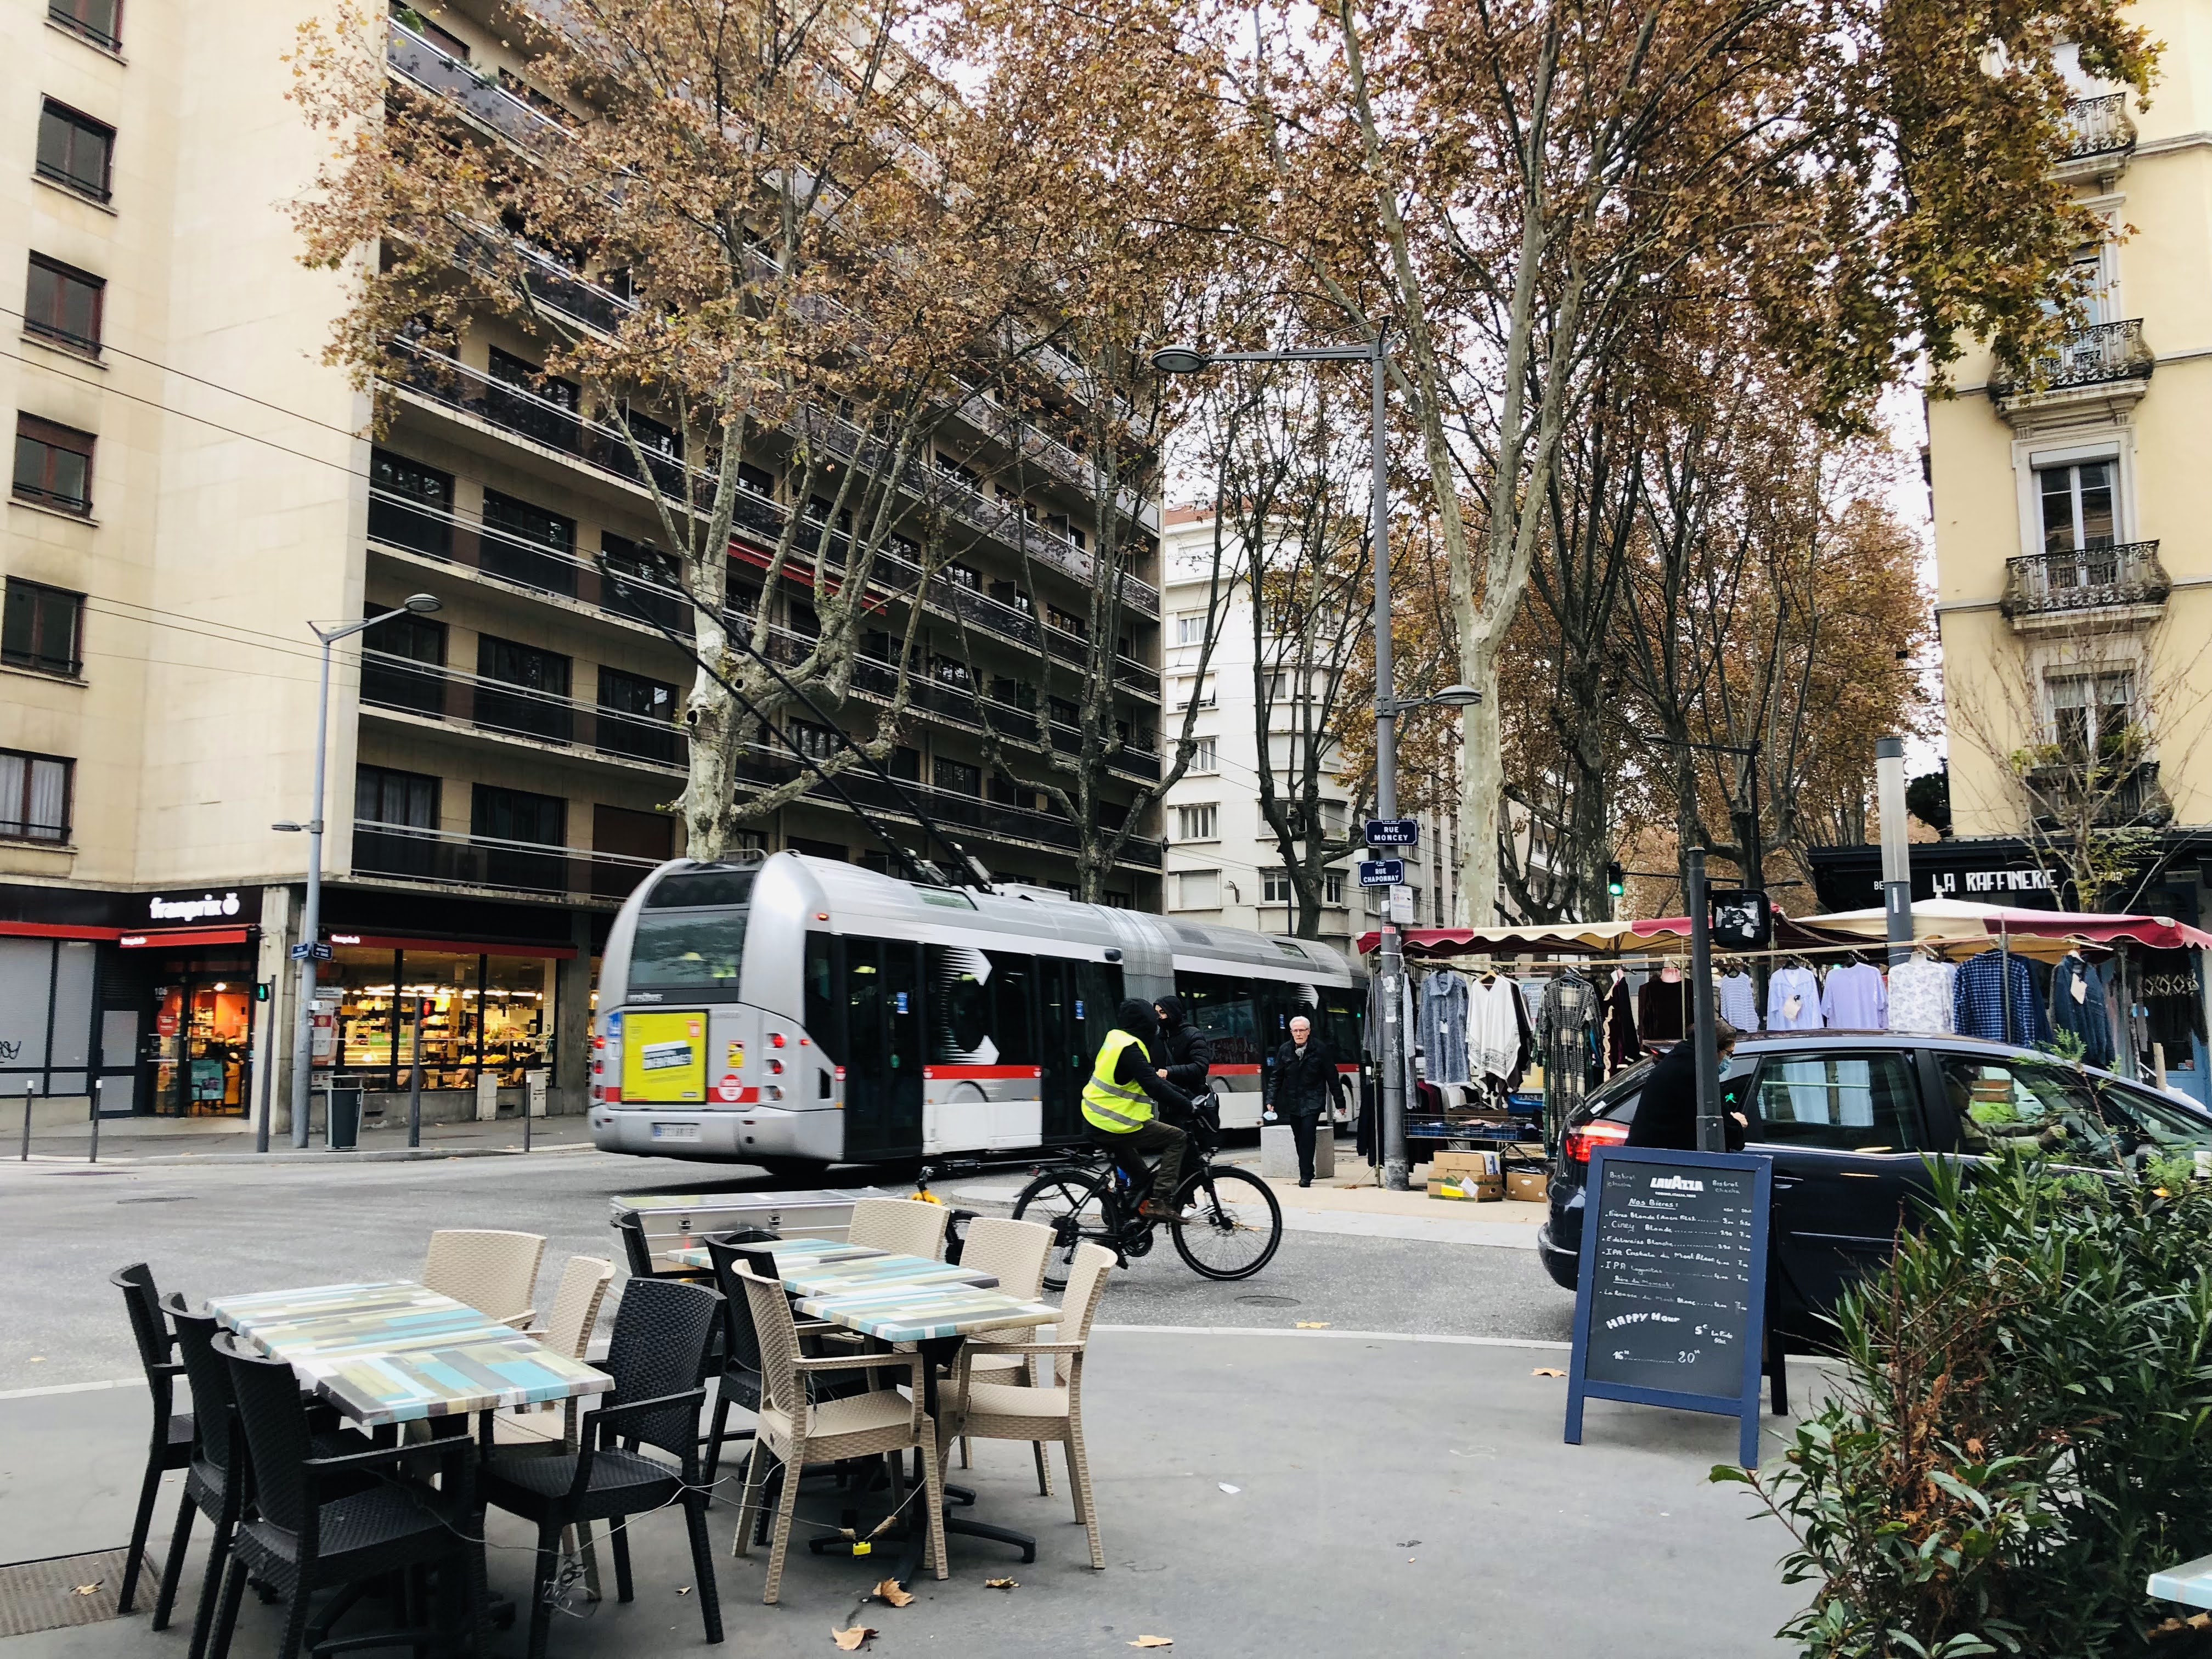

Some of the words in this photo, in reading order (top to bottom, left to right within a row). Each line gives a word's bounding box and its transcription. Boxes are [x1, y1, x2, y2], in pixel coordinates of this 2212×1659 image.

[1933, 873, 1955, 893] LA
[1966, 870, 2058, 891] RAFFINERIE
[150, 894, 222, 922] franprix
[1650, 1176, 1704, 1191] LAVAZZA
[1629, 1198, 1645, 1206] Nos
[1605, 1261, 1626, 1270] IPA
[1606, 1313, 1649, 1329] HAPPY
[1651, 1312, 1680, 1322] Hour
